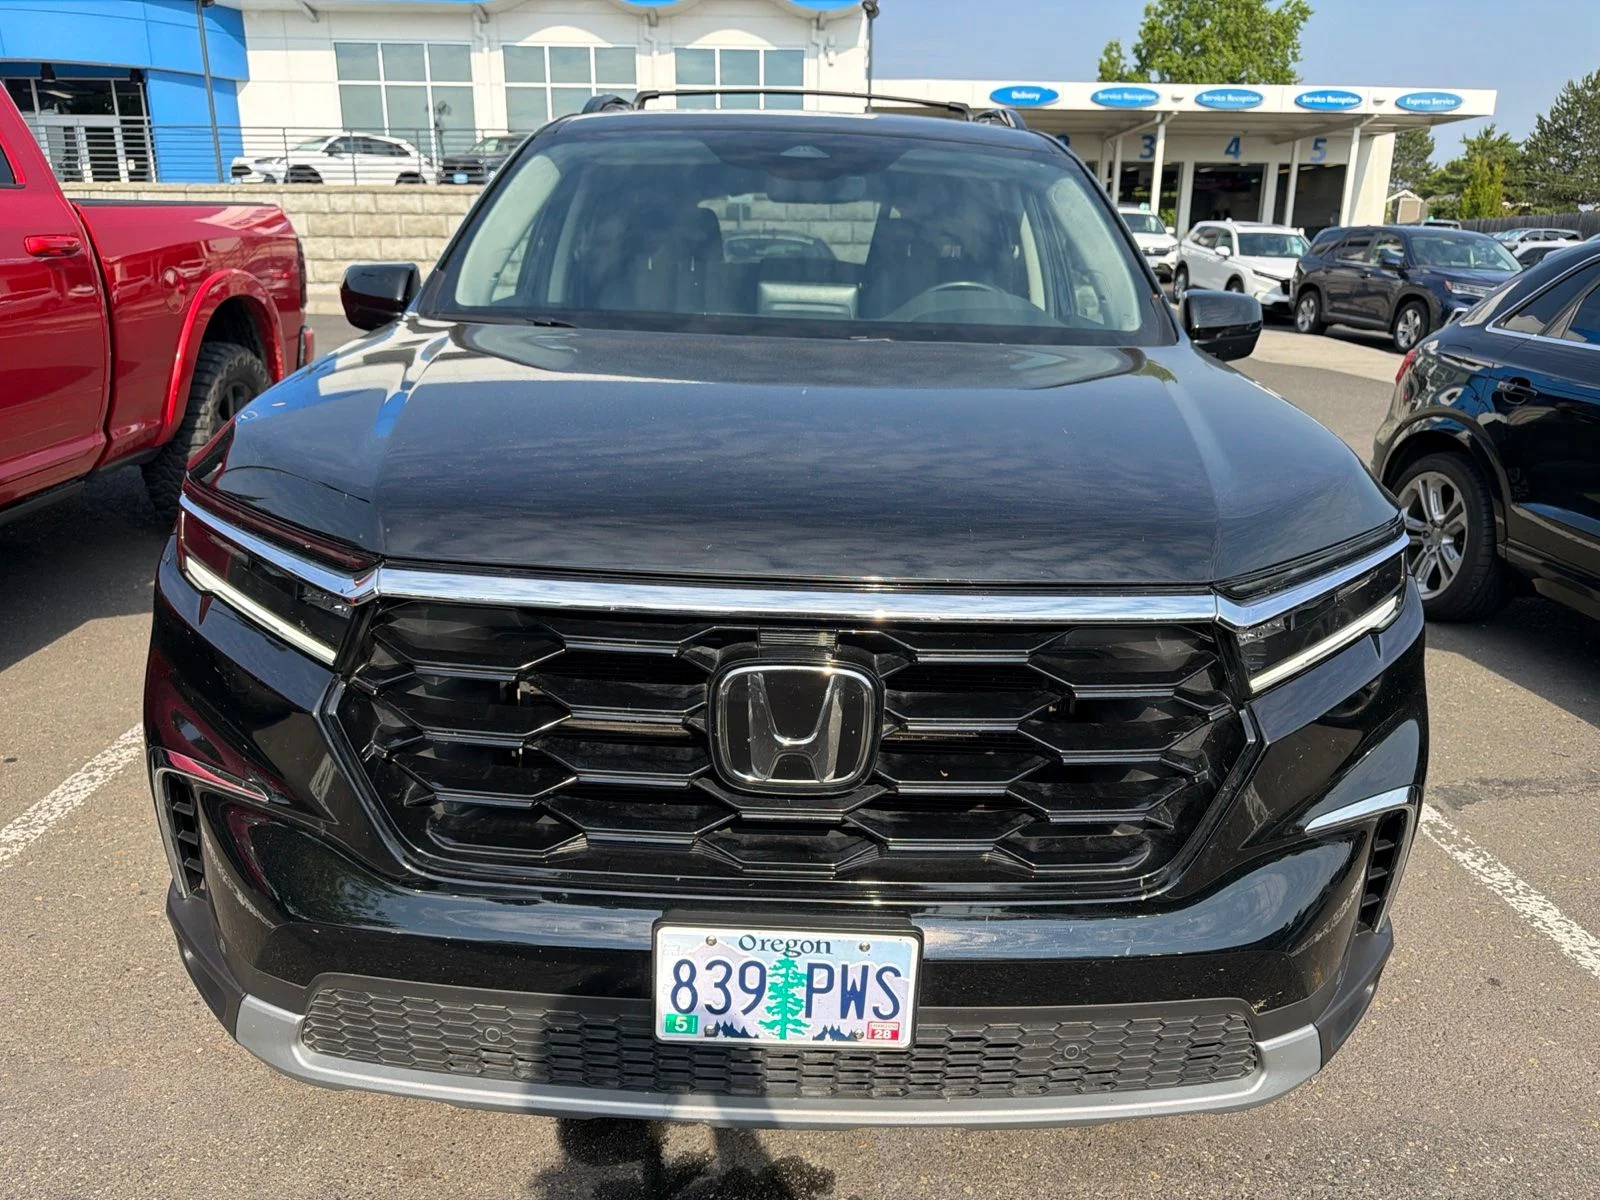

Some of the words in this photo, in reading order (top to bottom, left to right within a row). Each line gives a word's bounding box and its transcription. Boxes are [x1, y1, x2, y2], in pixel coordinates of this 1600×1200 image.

[1097, 92, 1121, 100] Service
[1202, 93, 1226, 101] Service
[1301, 95, 1326, 103] Service
[1326, 95, 1359, 105] Reception
[1406, 97, 1430, 105] Express
[1431, 97, 1455, 105] Service
[1139, 134, 1156, 159] 3
[1224, 136, 1242, 160] 4
[1310, 138, 1328, 162] 5
[738, 934, 833, 958] Oregon
[670, 958, 767, 1016] 839
[804, 962, 901, 1020] PWS
[674, 1015, 688, 1032] 5
[873, 1029, 892, 1040] 28
